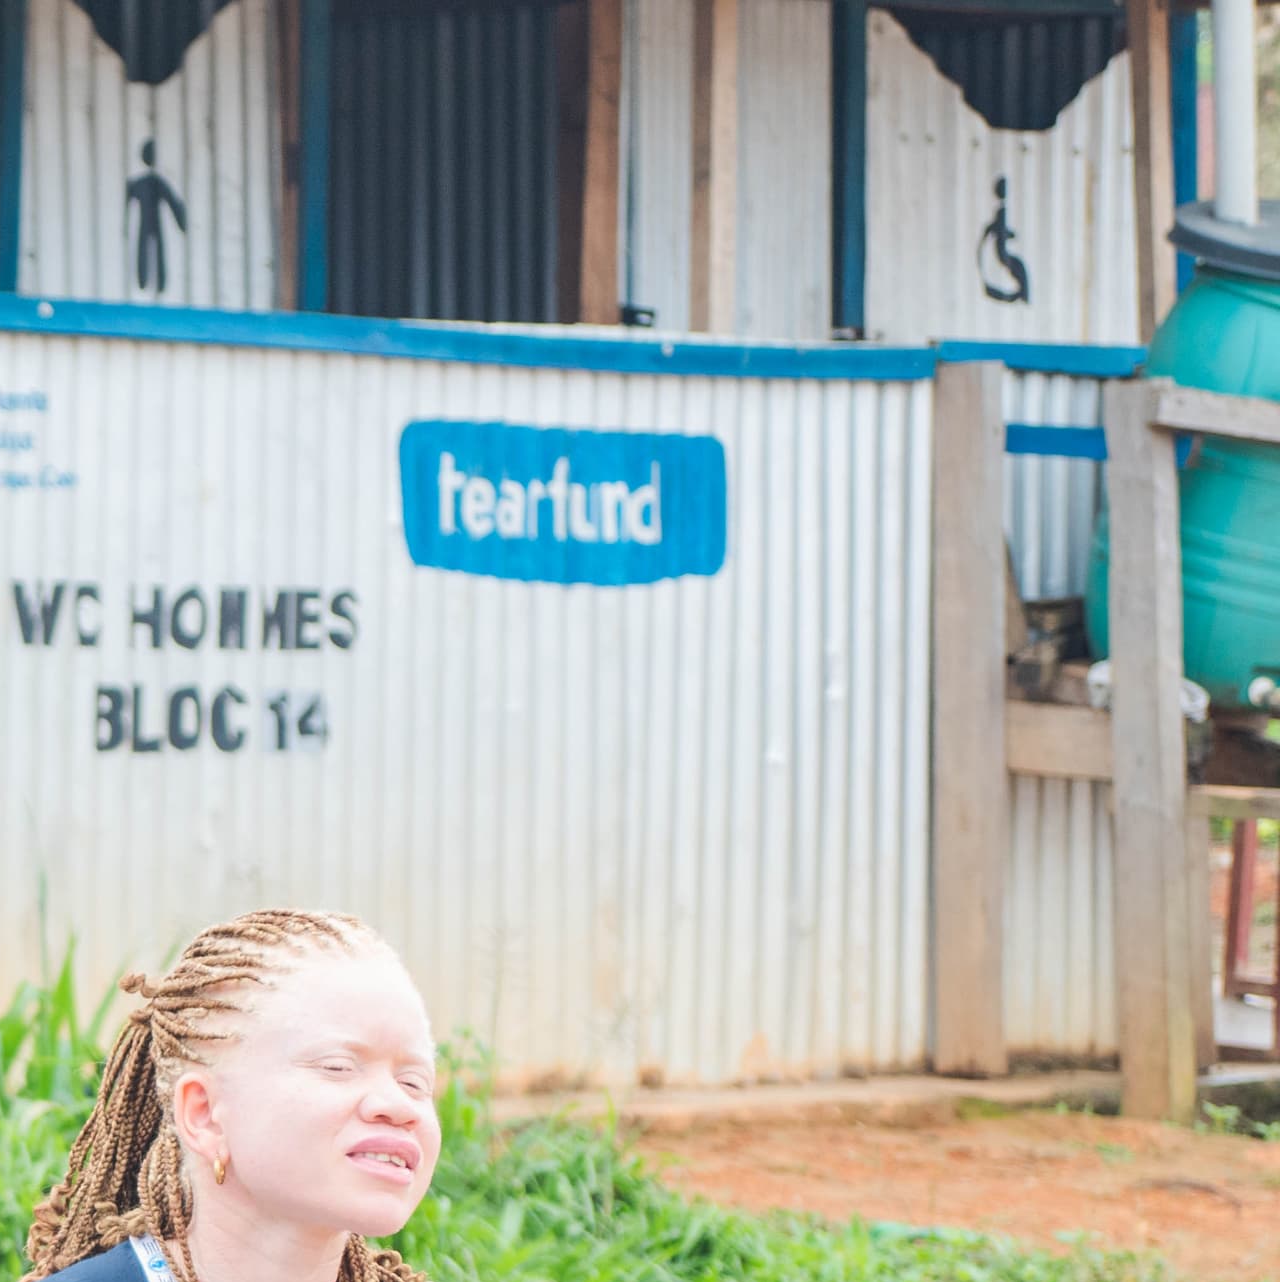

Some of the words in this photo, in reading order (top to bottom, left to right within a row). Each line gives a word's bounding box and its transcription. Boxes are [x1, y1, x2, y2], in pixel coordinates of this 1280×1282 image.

[439, 453, 662, 544] tearfund
[11, 580, 100, 646] WC
[130, 586, 359, 649] HOMMES
[96, 686, 245, 753] BLOC
[270, 692, 329, 752] 14
